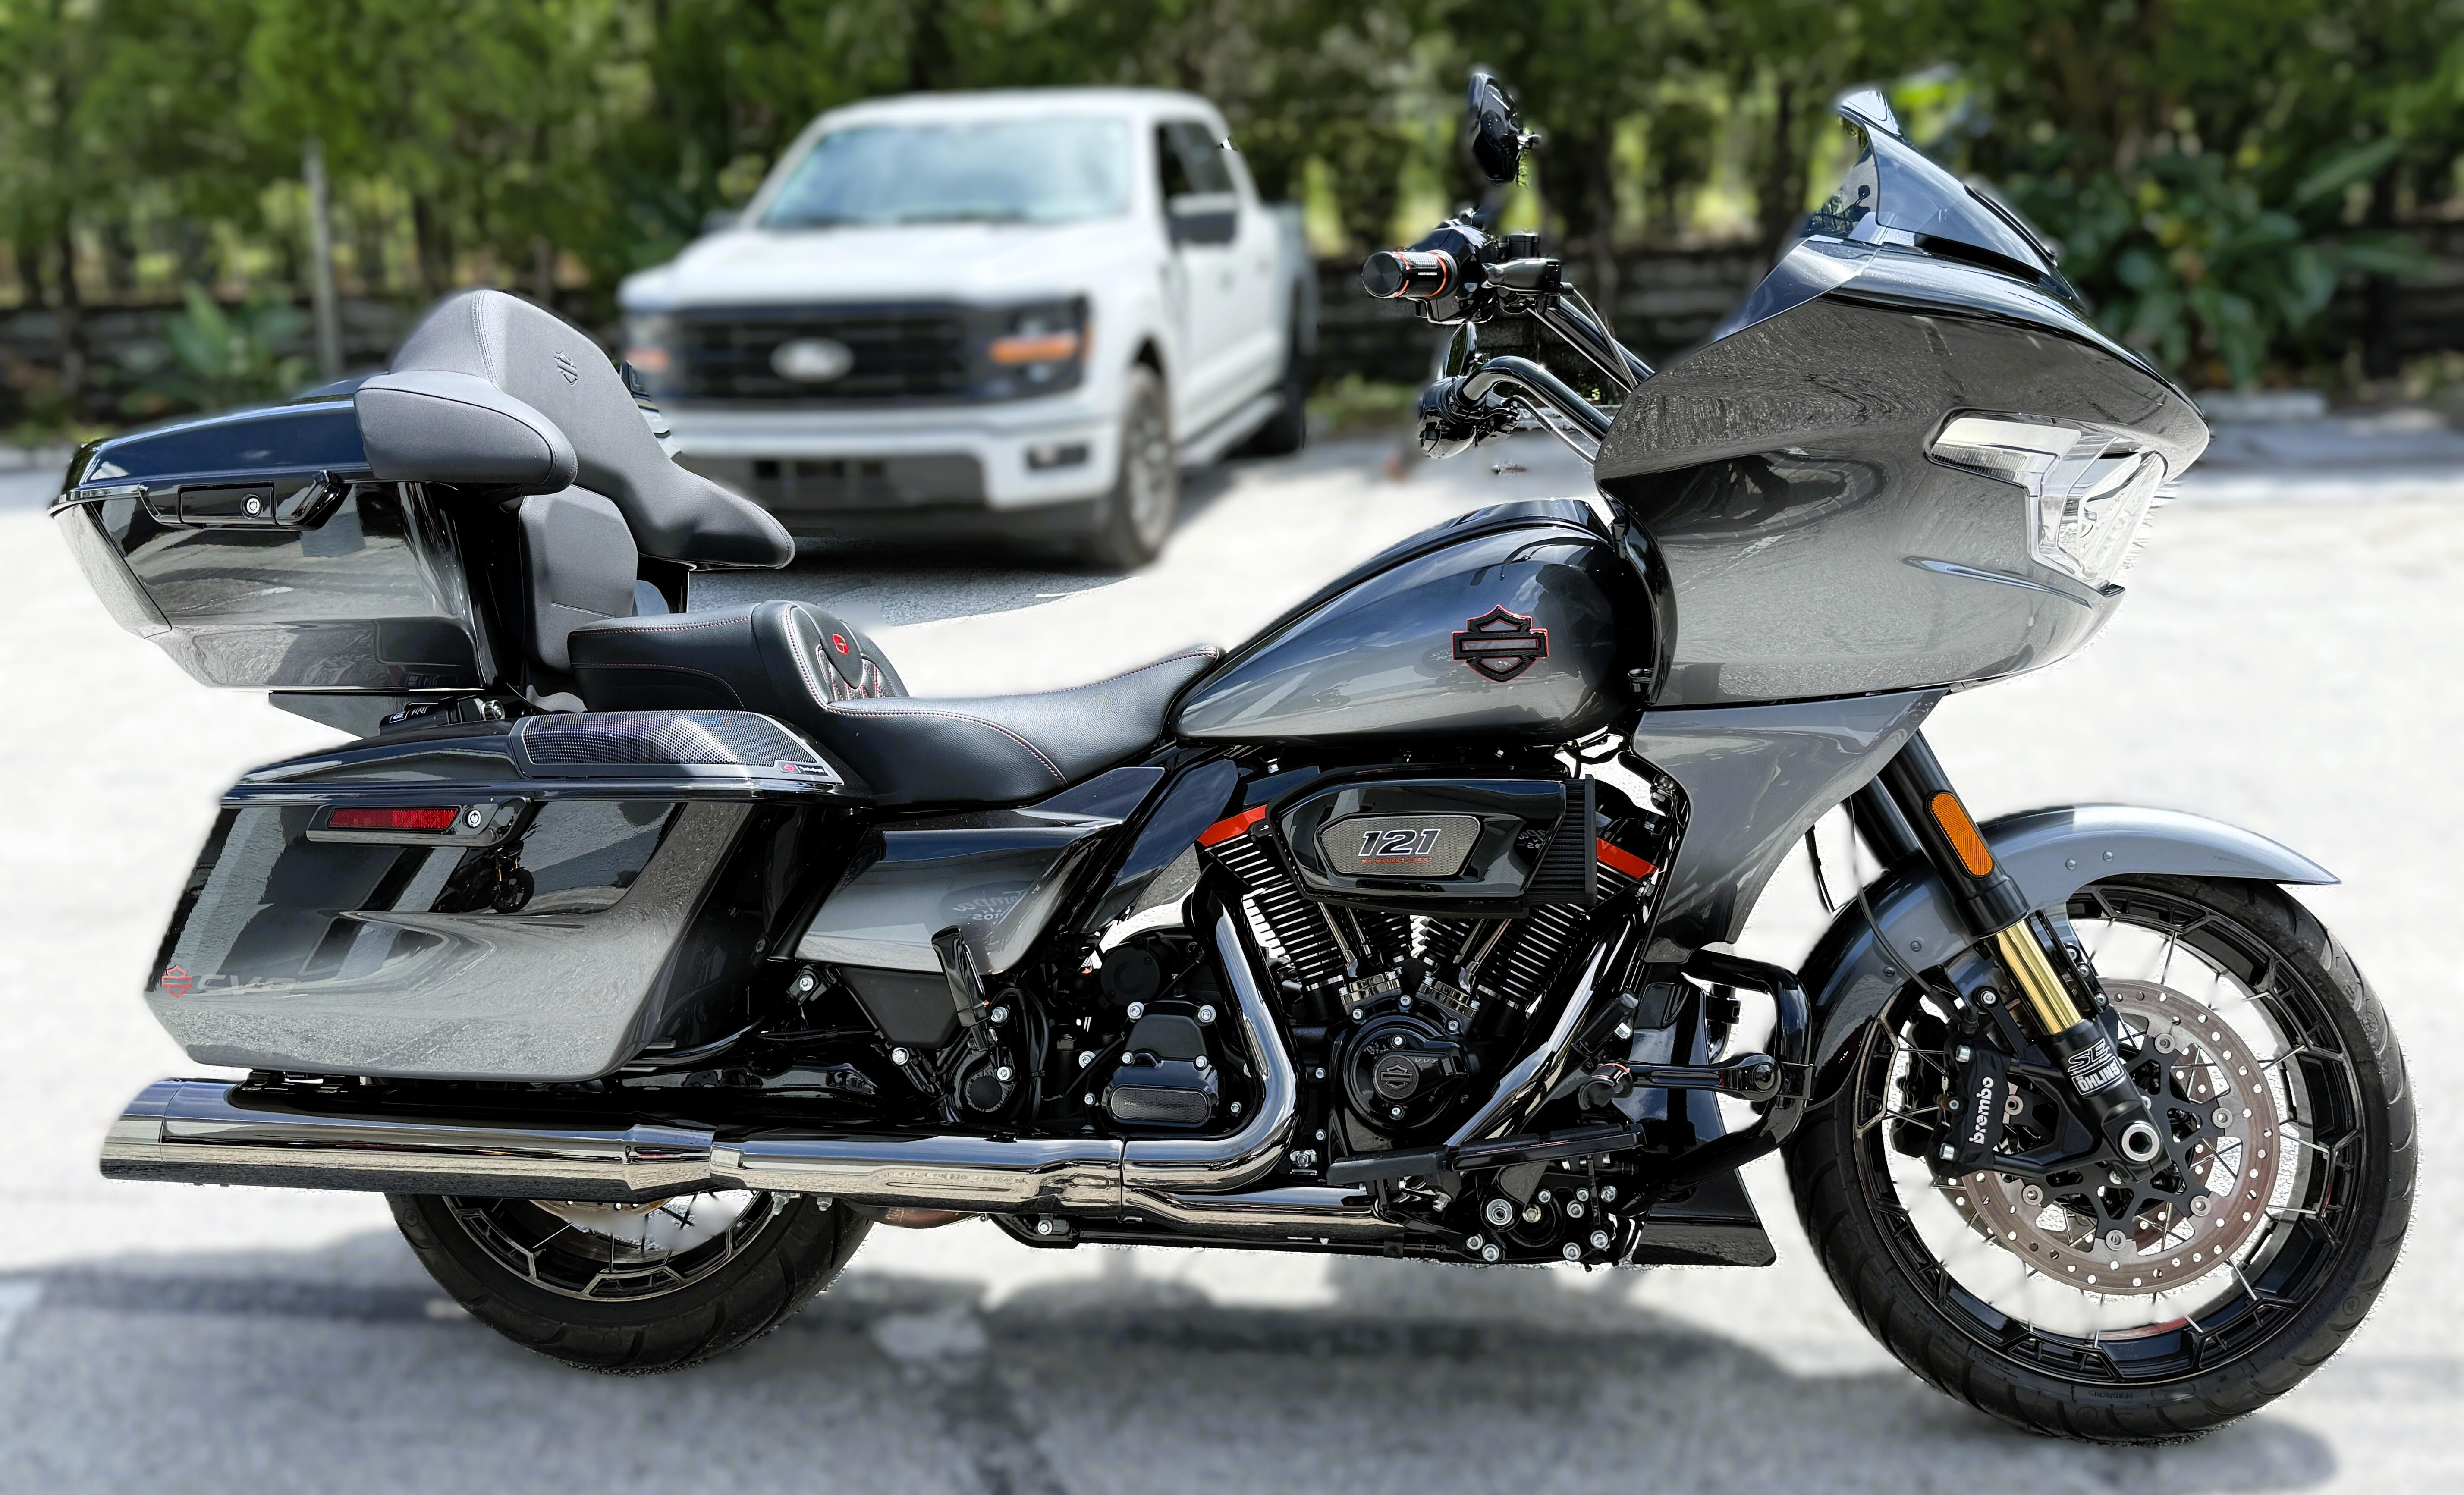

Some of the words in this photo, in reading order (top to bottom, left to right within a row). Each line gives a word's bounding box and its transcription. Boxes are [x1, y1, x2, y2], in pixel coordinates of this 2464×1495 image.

[1358, 829, 1441, 856] 121
[2068, 1038, 2110, 1072] SE
[2076, 1059, 2121, 1092] ÖHLINS
[1969, 1077, 1994, 1144] brembo
